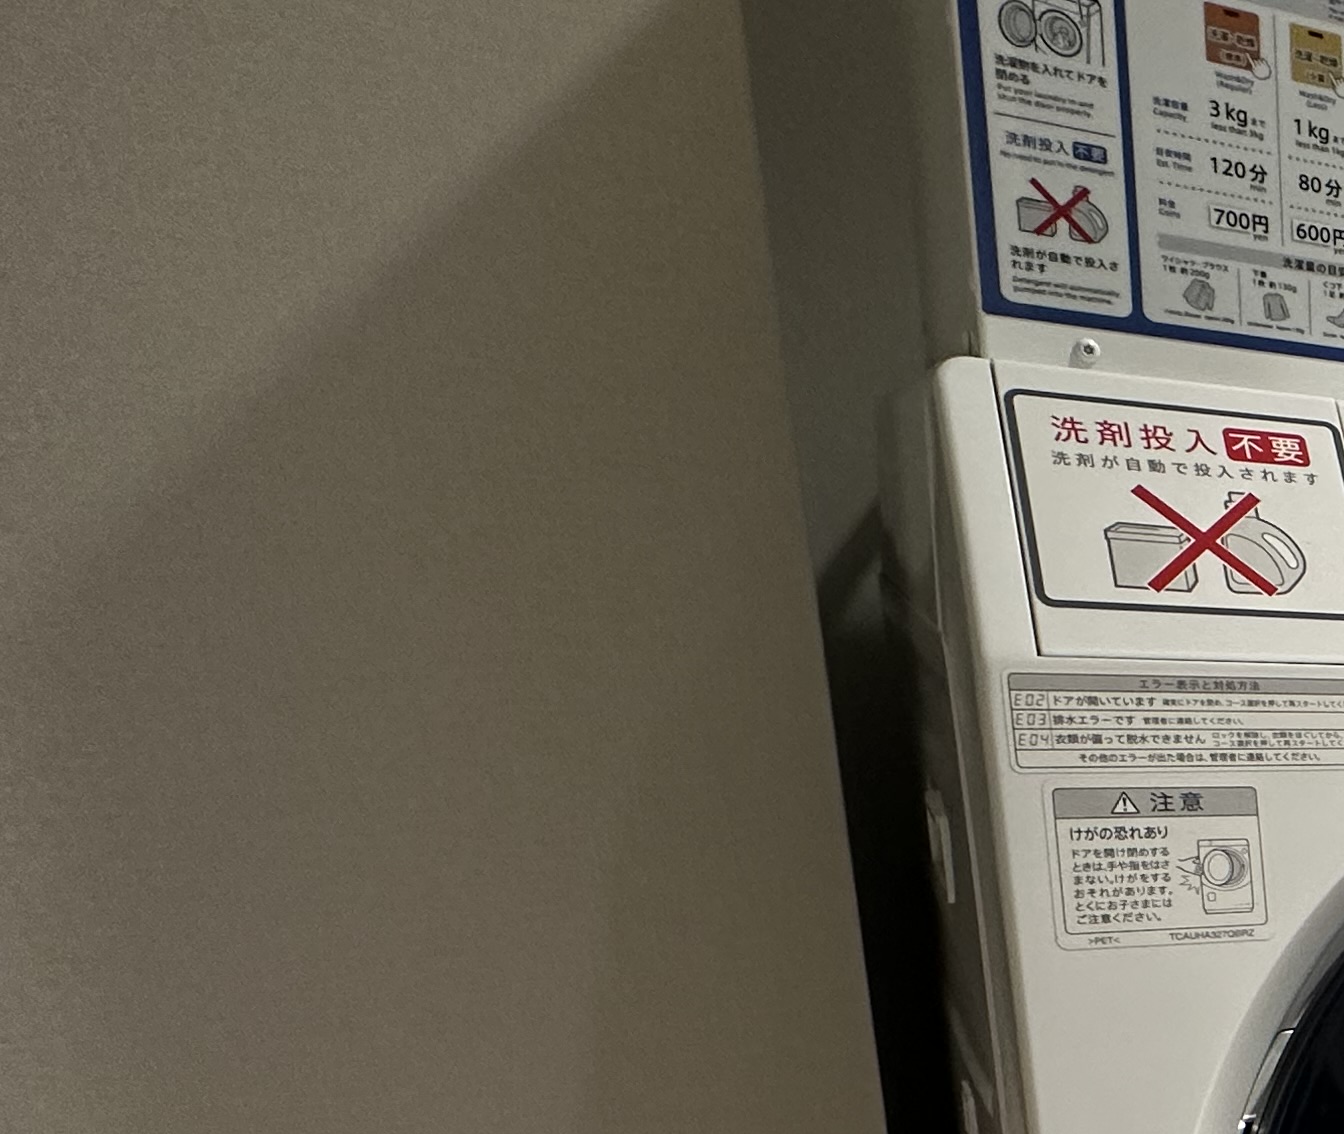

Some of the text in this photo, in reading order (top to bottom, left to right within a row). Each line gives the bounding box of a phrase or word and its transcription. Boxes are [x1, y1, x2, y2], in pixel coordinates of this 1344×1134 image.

[1209, 100, 1221, 118] 3
[1225, 102, 1248, 128] kg
[1307, 120, 1330, 145] kg
[1005, 131, 1071, 156] 洗剤投入
[1210, 157, 1268, 185] 120分
[1298, 174, 1342, 199] 80分
[1213, 208, 1269, 234] 700円
[1050, 415, 1305, 465] 洗剤投入 不要
[1050, 450, 1320, 487] 洗剤が自動で投入されます
[1139, 679, 1260, 691] エラー表示と対処方法
[1014, 693, 1157, 707] E02 ドアが開いています
[1016, 713, 1047, 726] E03
[1053, 715, 1135, 726] 排水エラーです
[1018, 733, 1206, 746] E04 衣類が偏って脱水できません
[1150, 791, 1205, 813] 注意
[1069, 826, 1169, 841] けがの恐れあり
[1071, 847, 1170, 859] ドアを開け閉めする
[1072, 860, 1170, 872] ときは、手や指をはさ
[1074, 887, 1174, 899] おそれがあります。
[1075, 900, 1173, 912] とくにお子さまには
[1076, 913, 1162, 925] ご注意ください。
